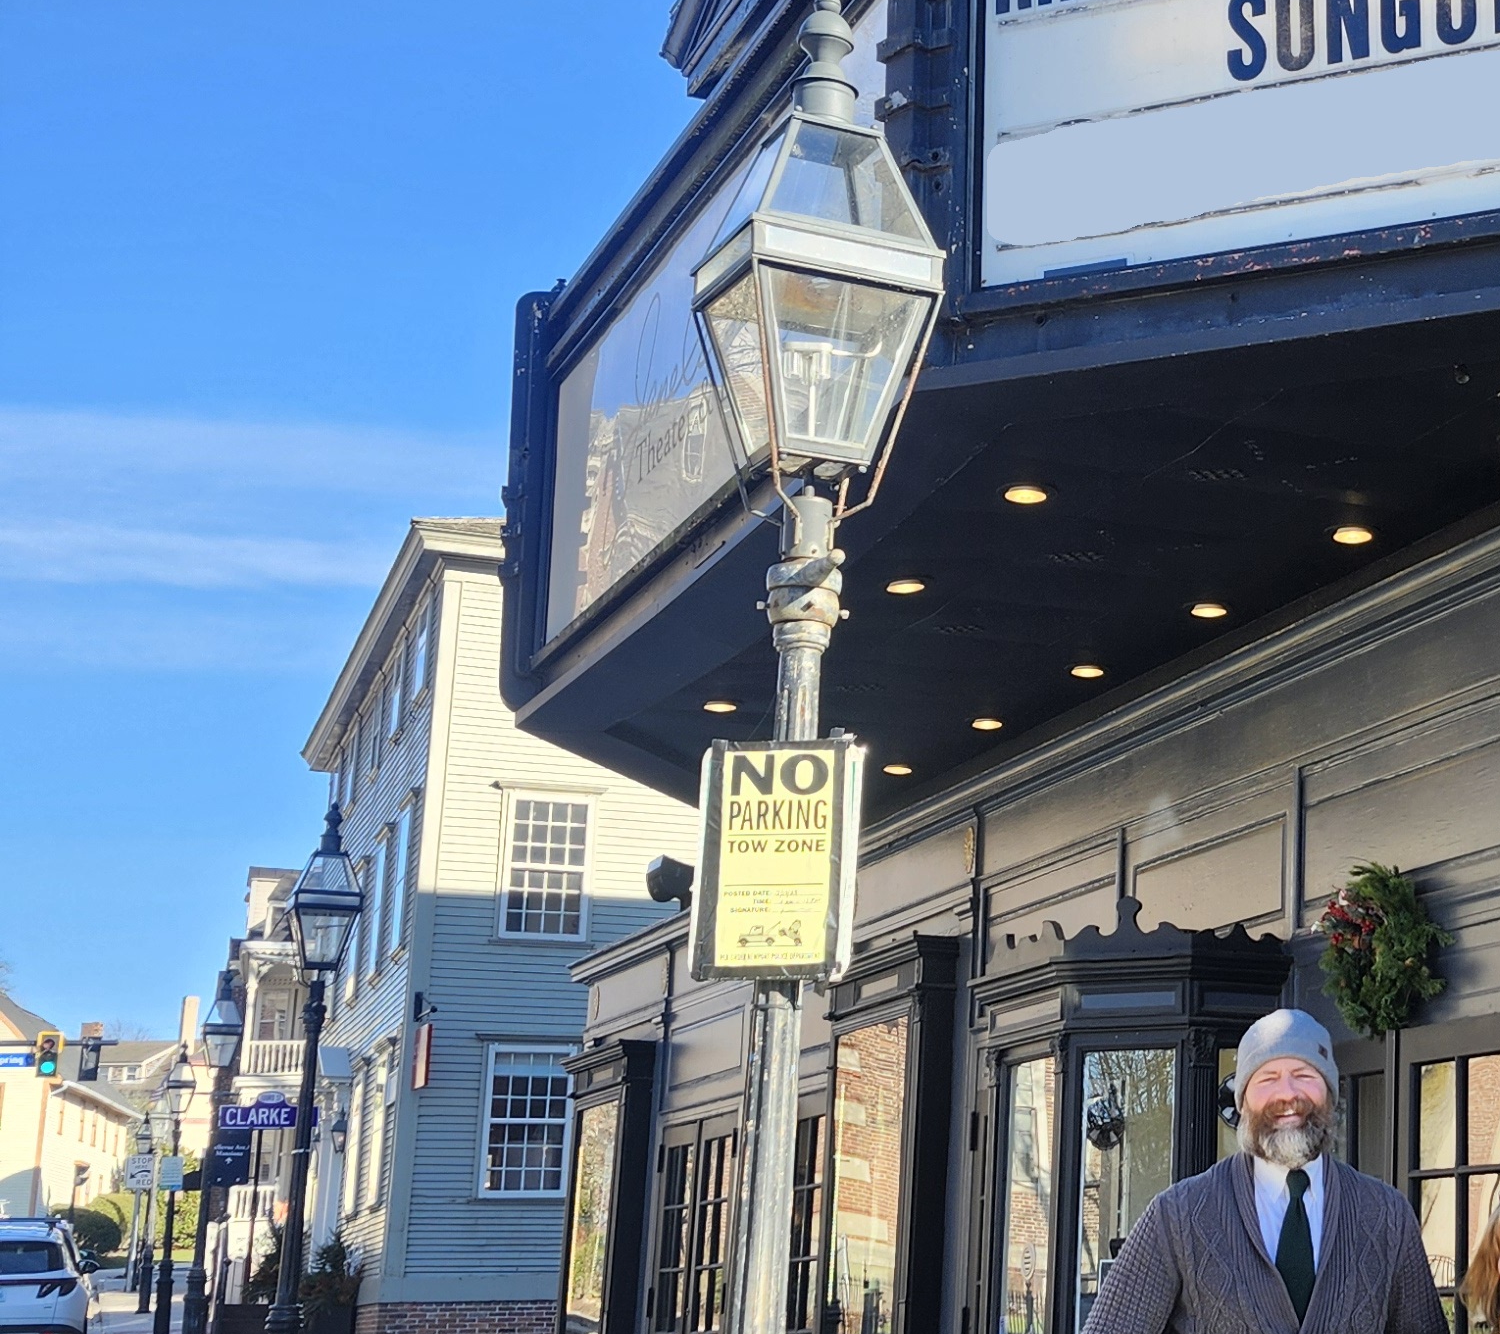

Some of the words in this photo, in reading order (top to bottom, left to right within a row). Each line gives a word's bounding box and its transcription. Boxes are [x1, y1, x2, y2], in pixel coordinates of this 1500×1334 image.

[635, 399, 702, 484] Theater
[731, 754, 829, 796] NO
[728, 799, 827, 830] PARKING
[727, 839, 768, 853] TOW
[774, 839, 826, 853] ZONE
[0, 1055, 24, 1066] pring
[225, 1108, 291, 1125] CLARKE
[131, 1157, 153, 1165] STOP
[136, 1178, 153, 1186] RED
